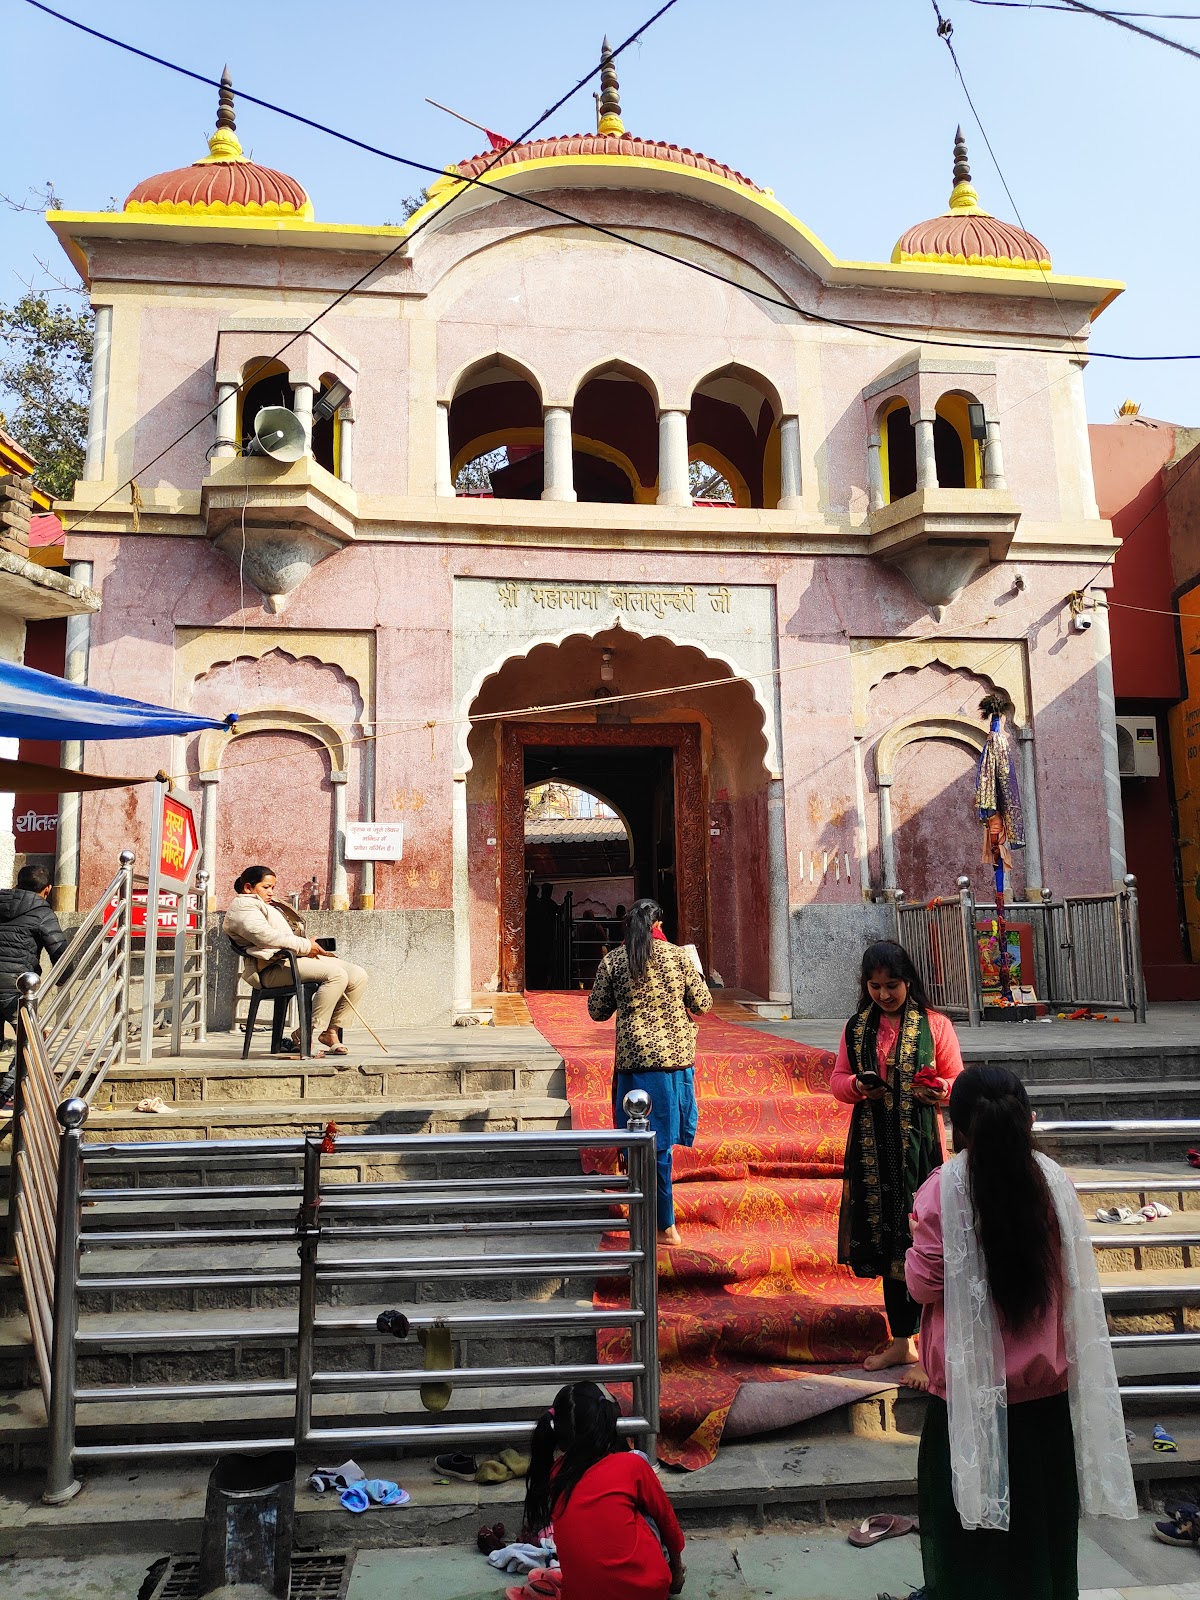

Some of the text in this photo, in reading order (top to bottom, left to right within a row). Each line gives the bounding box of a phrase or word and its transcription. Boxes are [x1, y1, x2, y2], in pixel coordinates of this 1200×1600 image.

[498, 581, 731, 619] श्री महामाया बालासुन्दरी जी
[166, 809, 185, 838] मुख्य
[162, 836, 185, 871] मन्दिर
